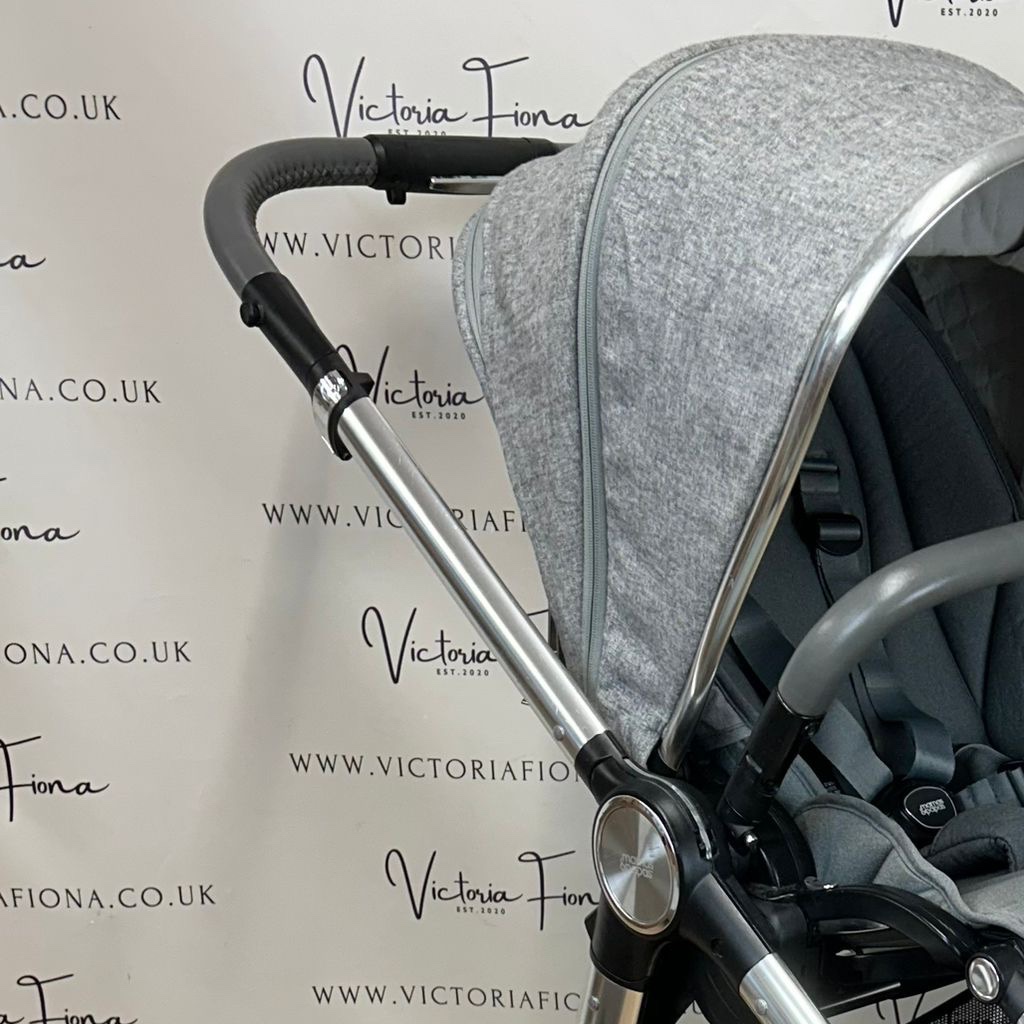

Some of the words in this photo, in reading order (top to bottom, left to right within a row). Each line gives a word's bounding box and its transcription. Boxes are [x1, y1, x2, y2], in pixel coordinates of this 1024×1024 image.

[940, 7, 999, 17] EST.2020
[411, 411, 467, 420] EST.2020
[361, 606, 498, 685] Victoria
[436, 668, 490, 676] EST.2020
[385, 848, 523, 920] Victoria
[518, 850, 600, 931] Fion
[456, 906, 506, 915] EST.2020
